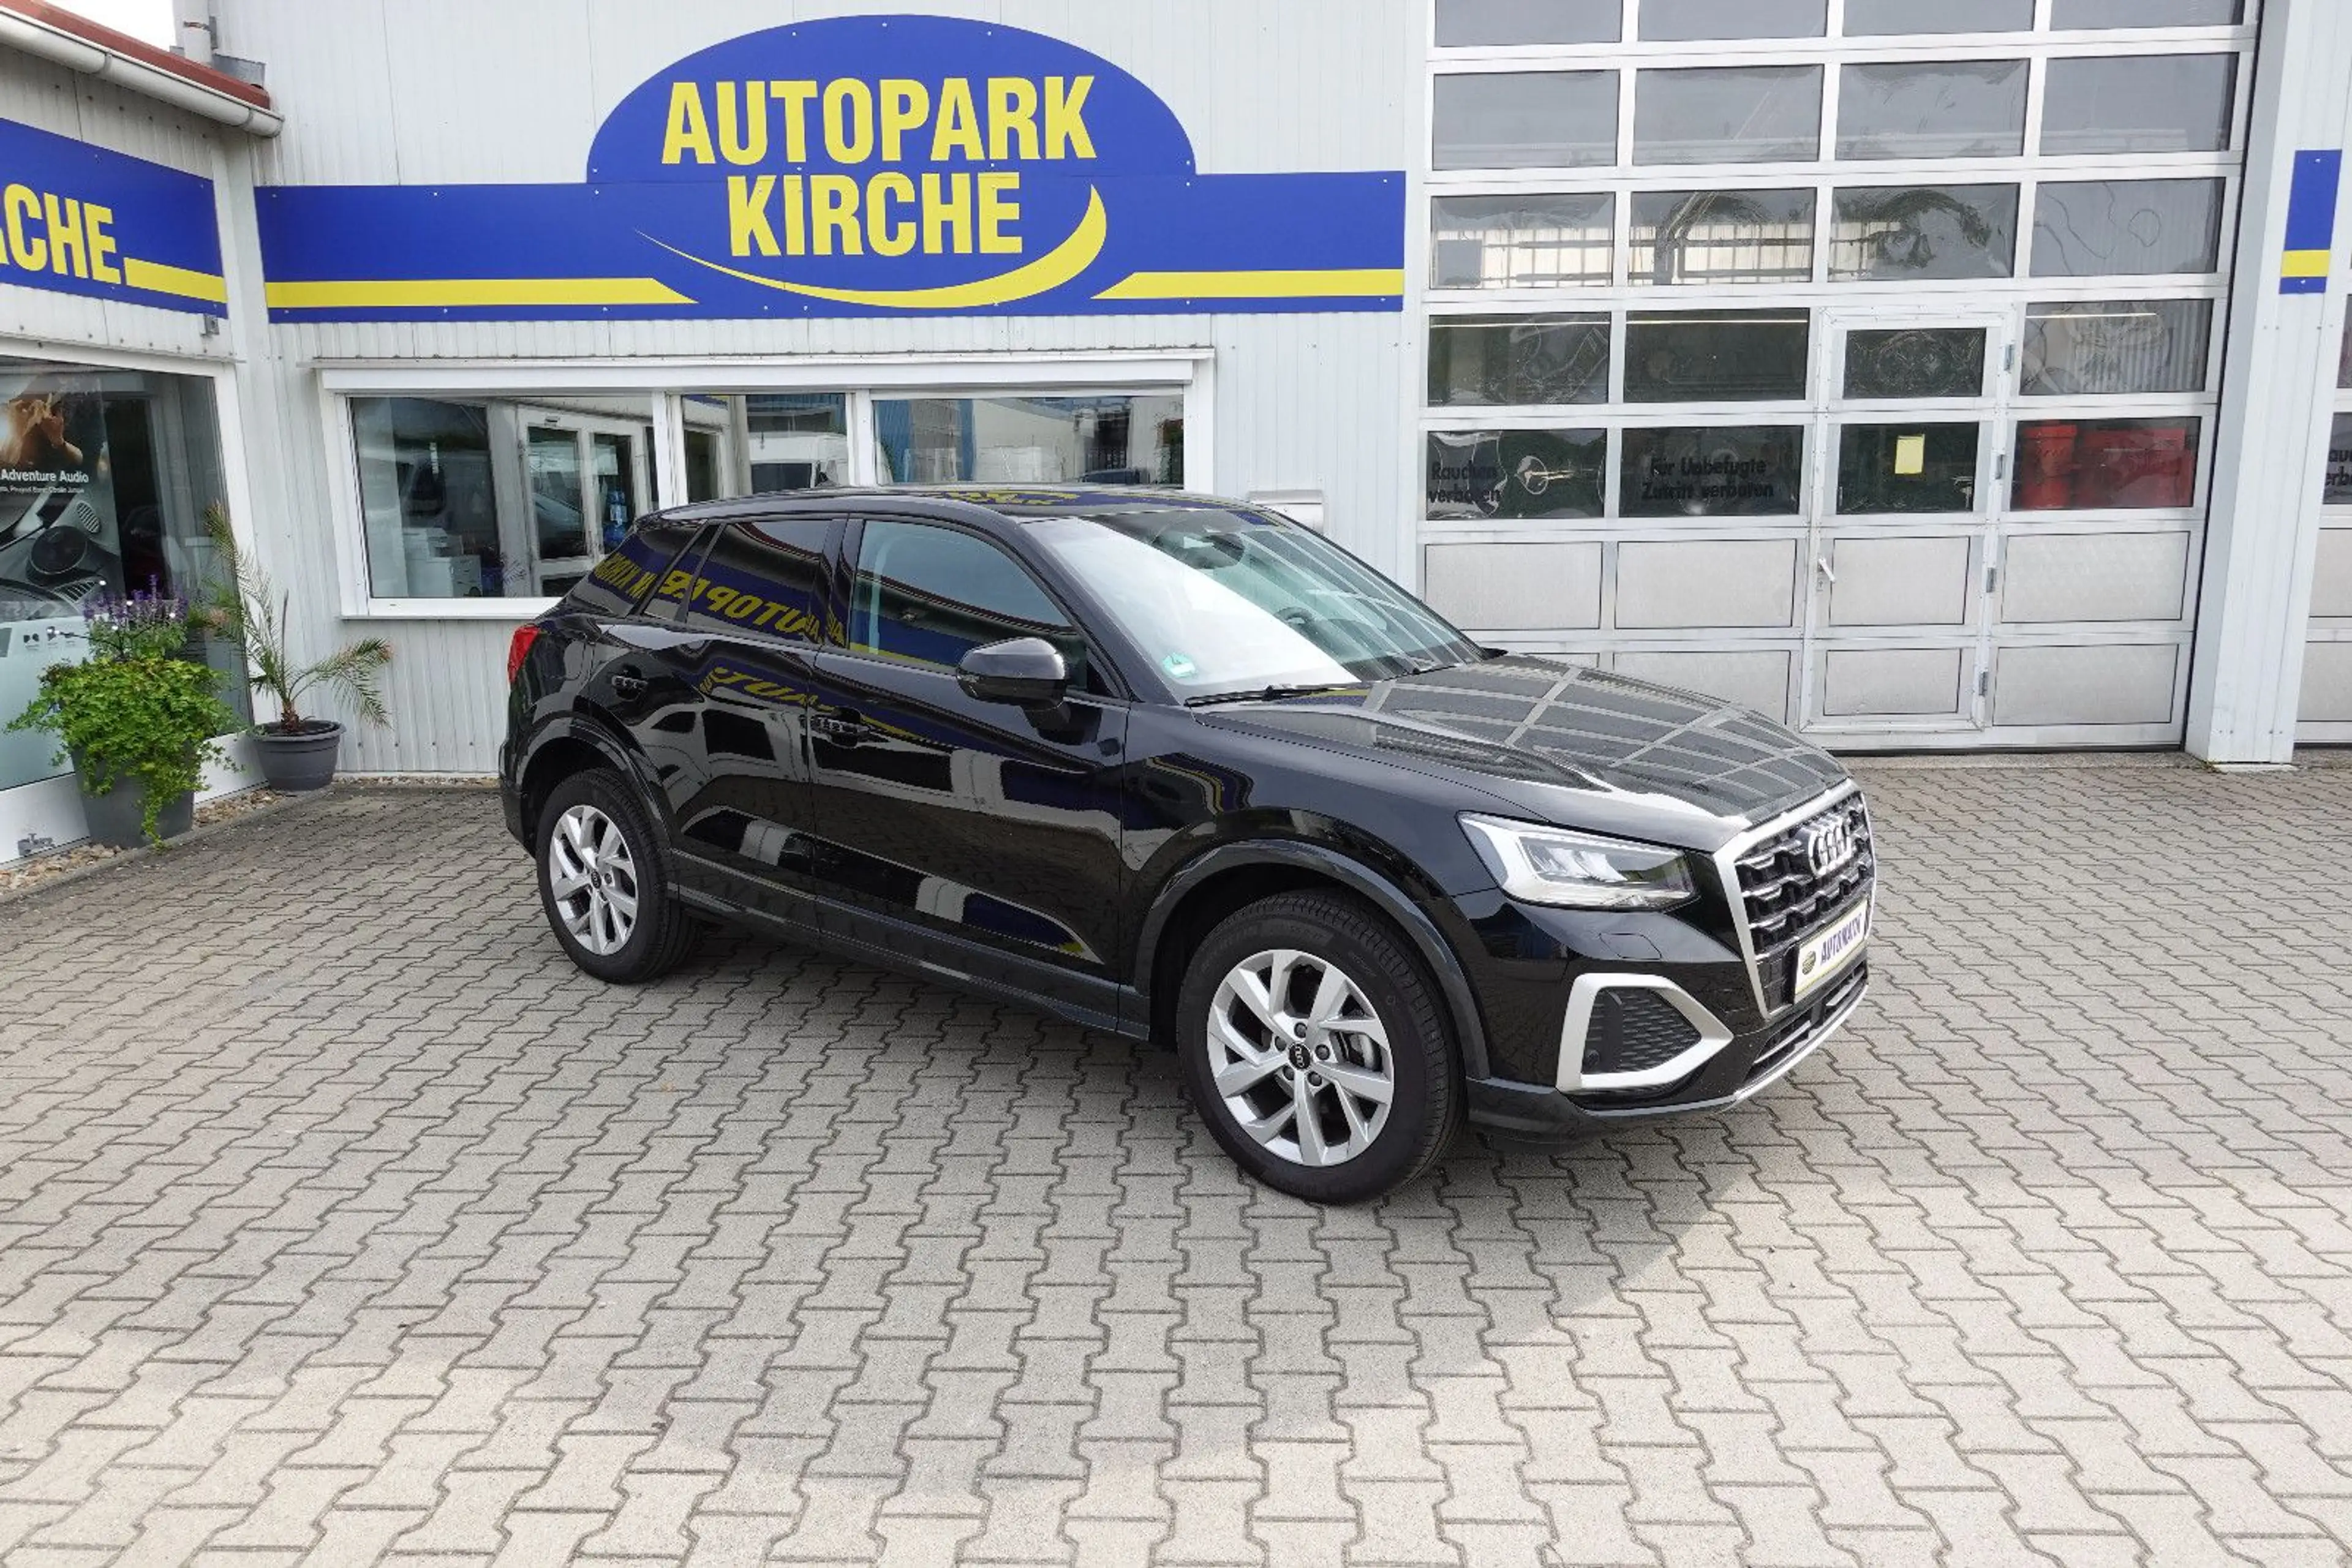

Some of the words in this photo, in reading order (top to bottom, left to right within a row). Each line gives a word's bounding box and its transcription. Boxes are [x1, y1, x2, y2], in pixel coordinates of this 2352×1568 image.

[662, 75, 1096, 165] AUTOPARK
[727, 172, 1022, 256] KIRCHE
[0, 469, 57, 481] Adventure
[59, 470, 89, 483] Audio
